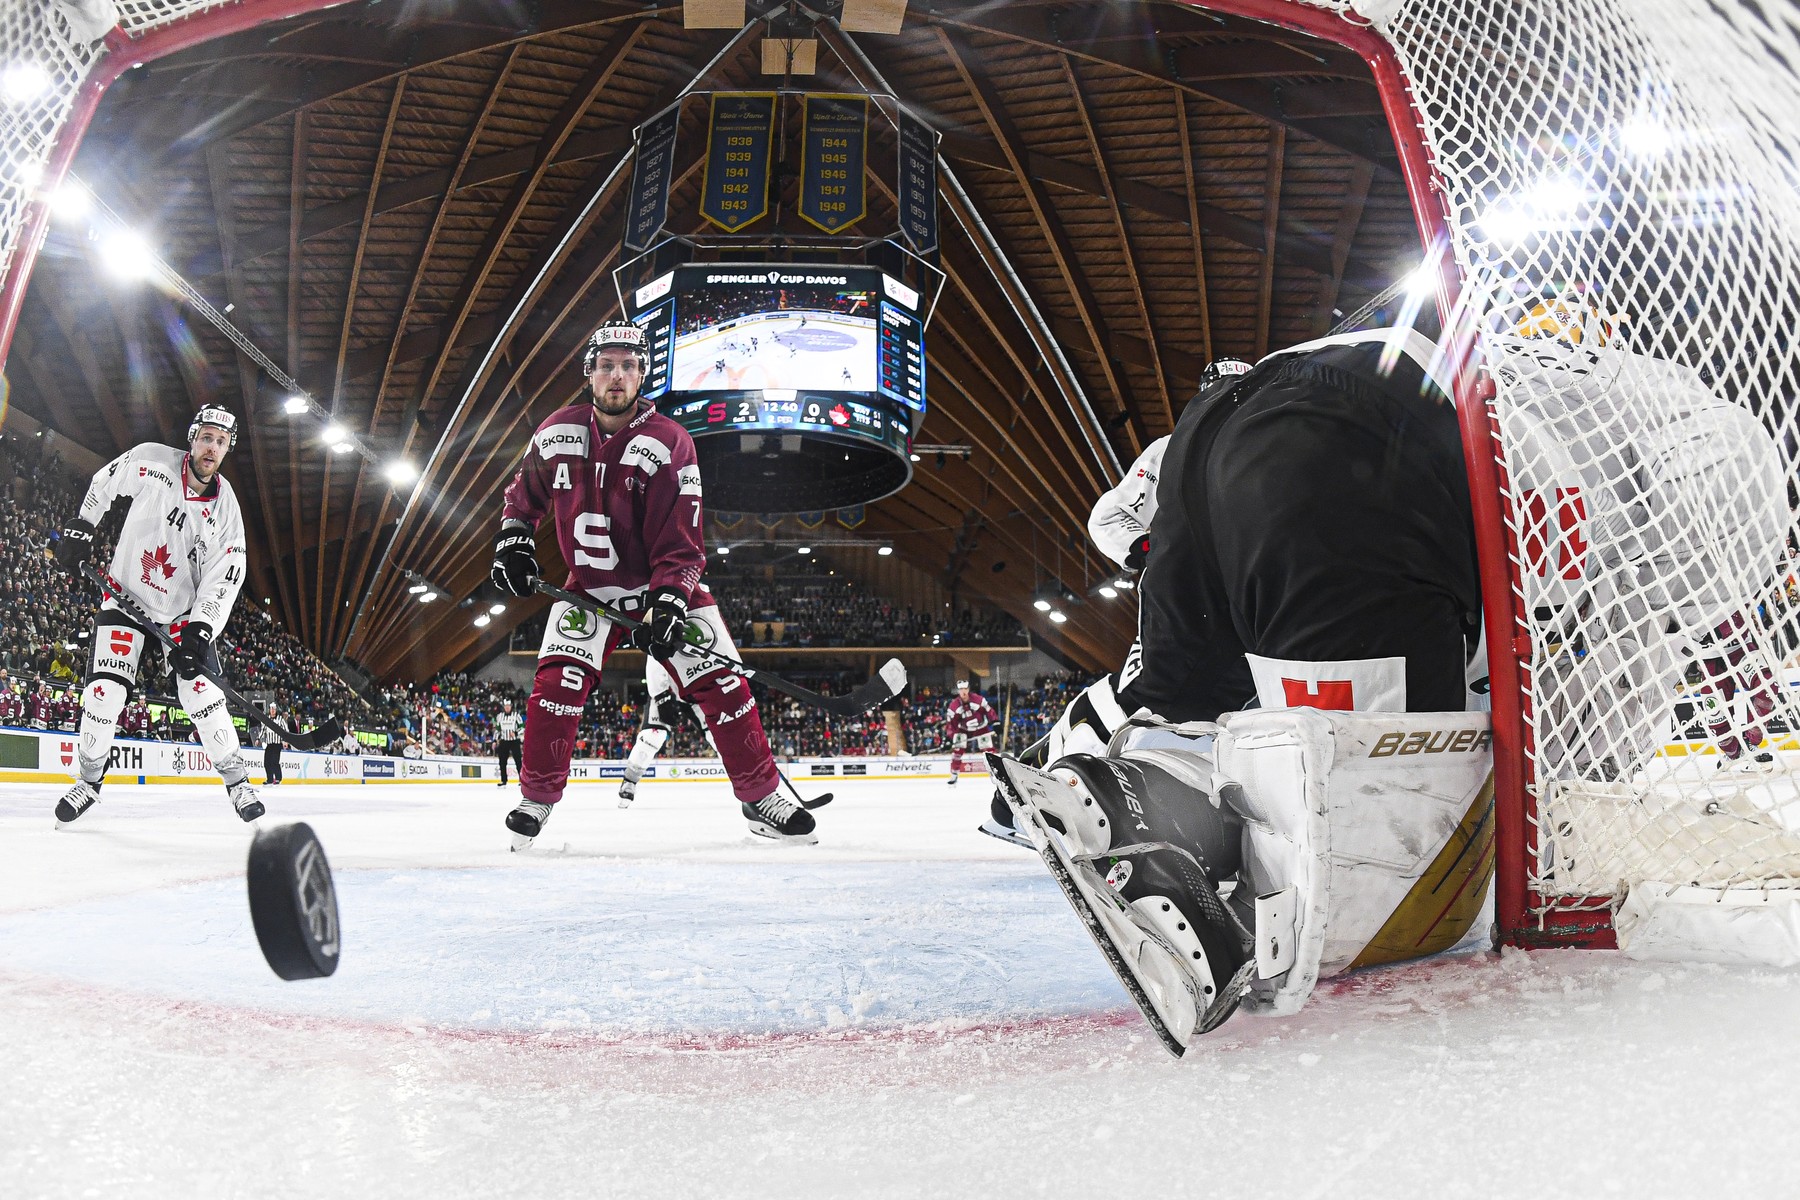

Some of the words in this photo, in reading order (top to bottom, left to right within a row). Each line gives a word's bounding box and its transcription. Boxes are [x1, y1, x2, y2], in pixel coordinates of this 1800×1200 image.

[727, 137, 753, 146] 1938
[822, 138, 848, 148] 1944
[726, 152, 752, 161] 1939
[821, 154, 847, 163] 1945
[726, 168, 749, 177] 1941
[820, 170, 847, 179] 1946
[723, 184, 749, 194] 1942
[821, 185, 846, 195] 1947
[721, 200, 747, 210] 1943
[819, 202, 846, 212] 1948
[706, 275, 767, 284] SPENGLER
[780, 275, 804, 284] CUP
[805, 275, 847, 285] DAVOS
[613, 329, 639, 340] UBS
[738, 402, 750, 416] 2
[808, 403, 820, 417] 0
[215, 412, 231, 423] UBS
[777, 415, 793, 424] PER
[541, 434, 584, 450] ŠKODA
[147, 469, 173, 488] WÜRTH
[552, 462, 572, 490] A
[166, 506, 187, 532] 44
[691, 501, 700, 527] 7
[63, 528, 94, 543] CCM
[573, 512, 620, 571] S
[225, 565, 241, 585] 44
[140, 577, 168, 594] CANADA
[546, 643, 594, 663] ŠKODA
[97, 658, 135, 677] WÜRTH
[560, 665, 585, 691] S
[1708, 715, 1727, 724] ŠKODA
[333, 760, 349, 774] UBS
[409, 765, 428, 775] ŠKODA
[684, 767, 726, 776] ŠKODA
[885, 762, 932, 772] helvetic
